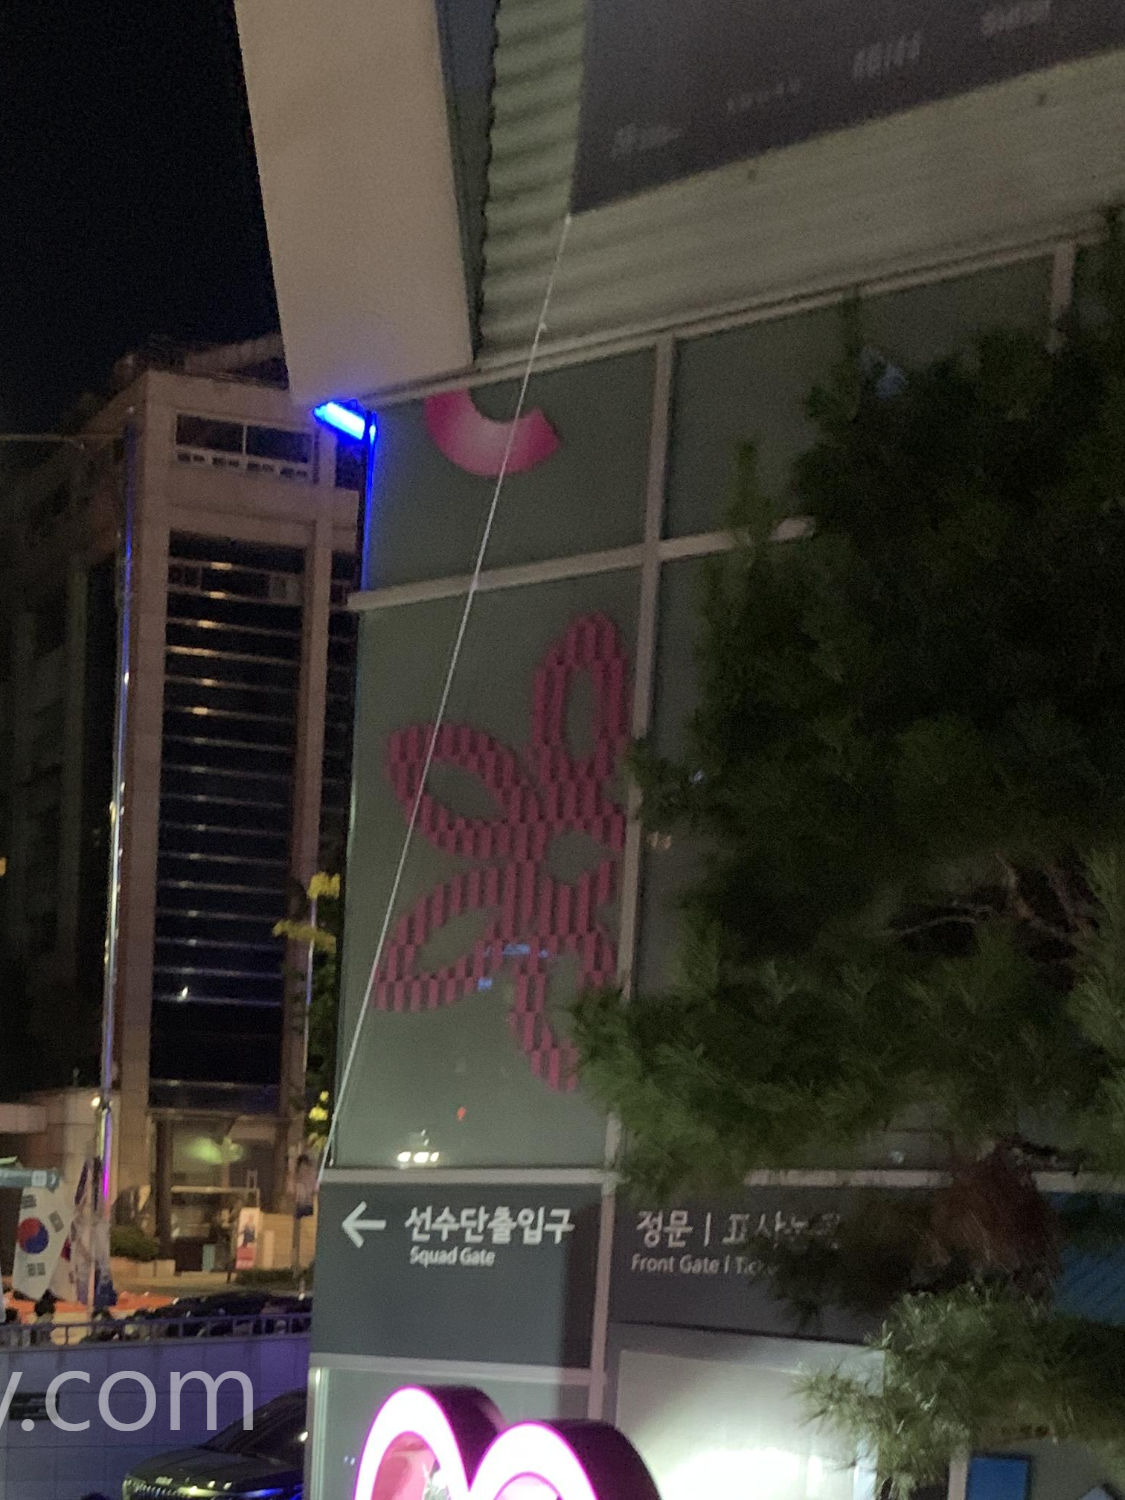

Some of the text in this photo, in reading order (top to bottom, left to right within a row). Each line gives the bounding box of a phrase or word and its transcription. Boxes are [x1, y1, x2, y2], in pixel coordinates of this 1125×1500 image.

[404, 1205, 575, 1245] 선수단출입구
[636, 1209, 693, 1249] 정문
[410, 1245, 496, 1268] Squad Gate
[631, 1253, 674, 1273] Front
[679, 1253, 720, 1275] Gate
